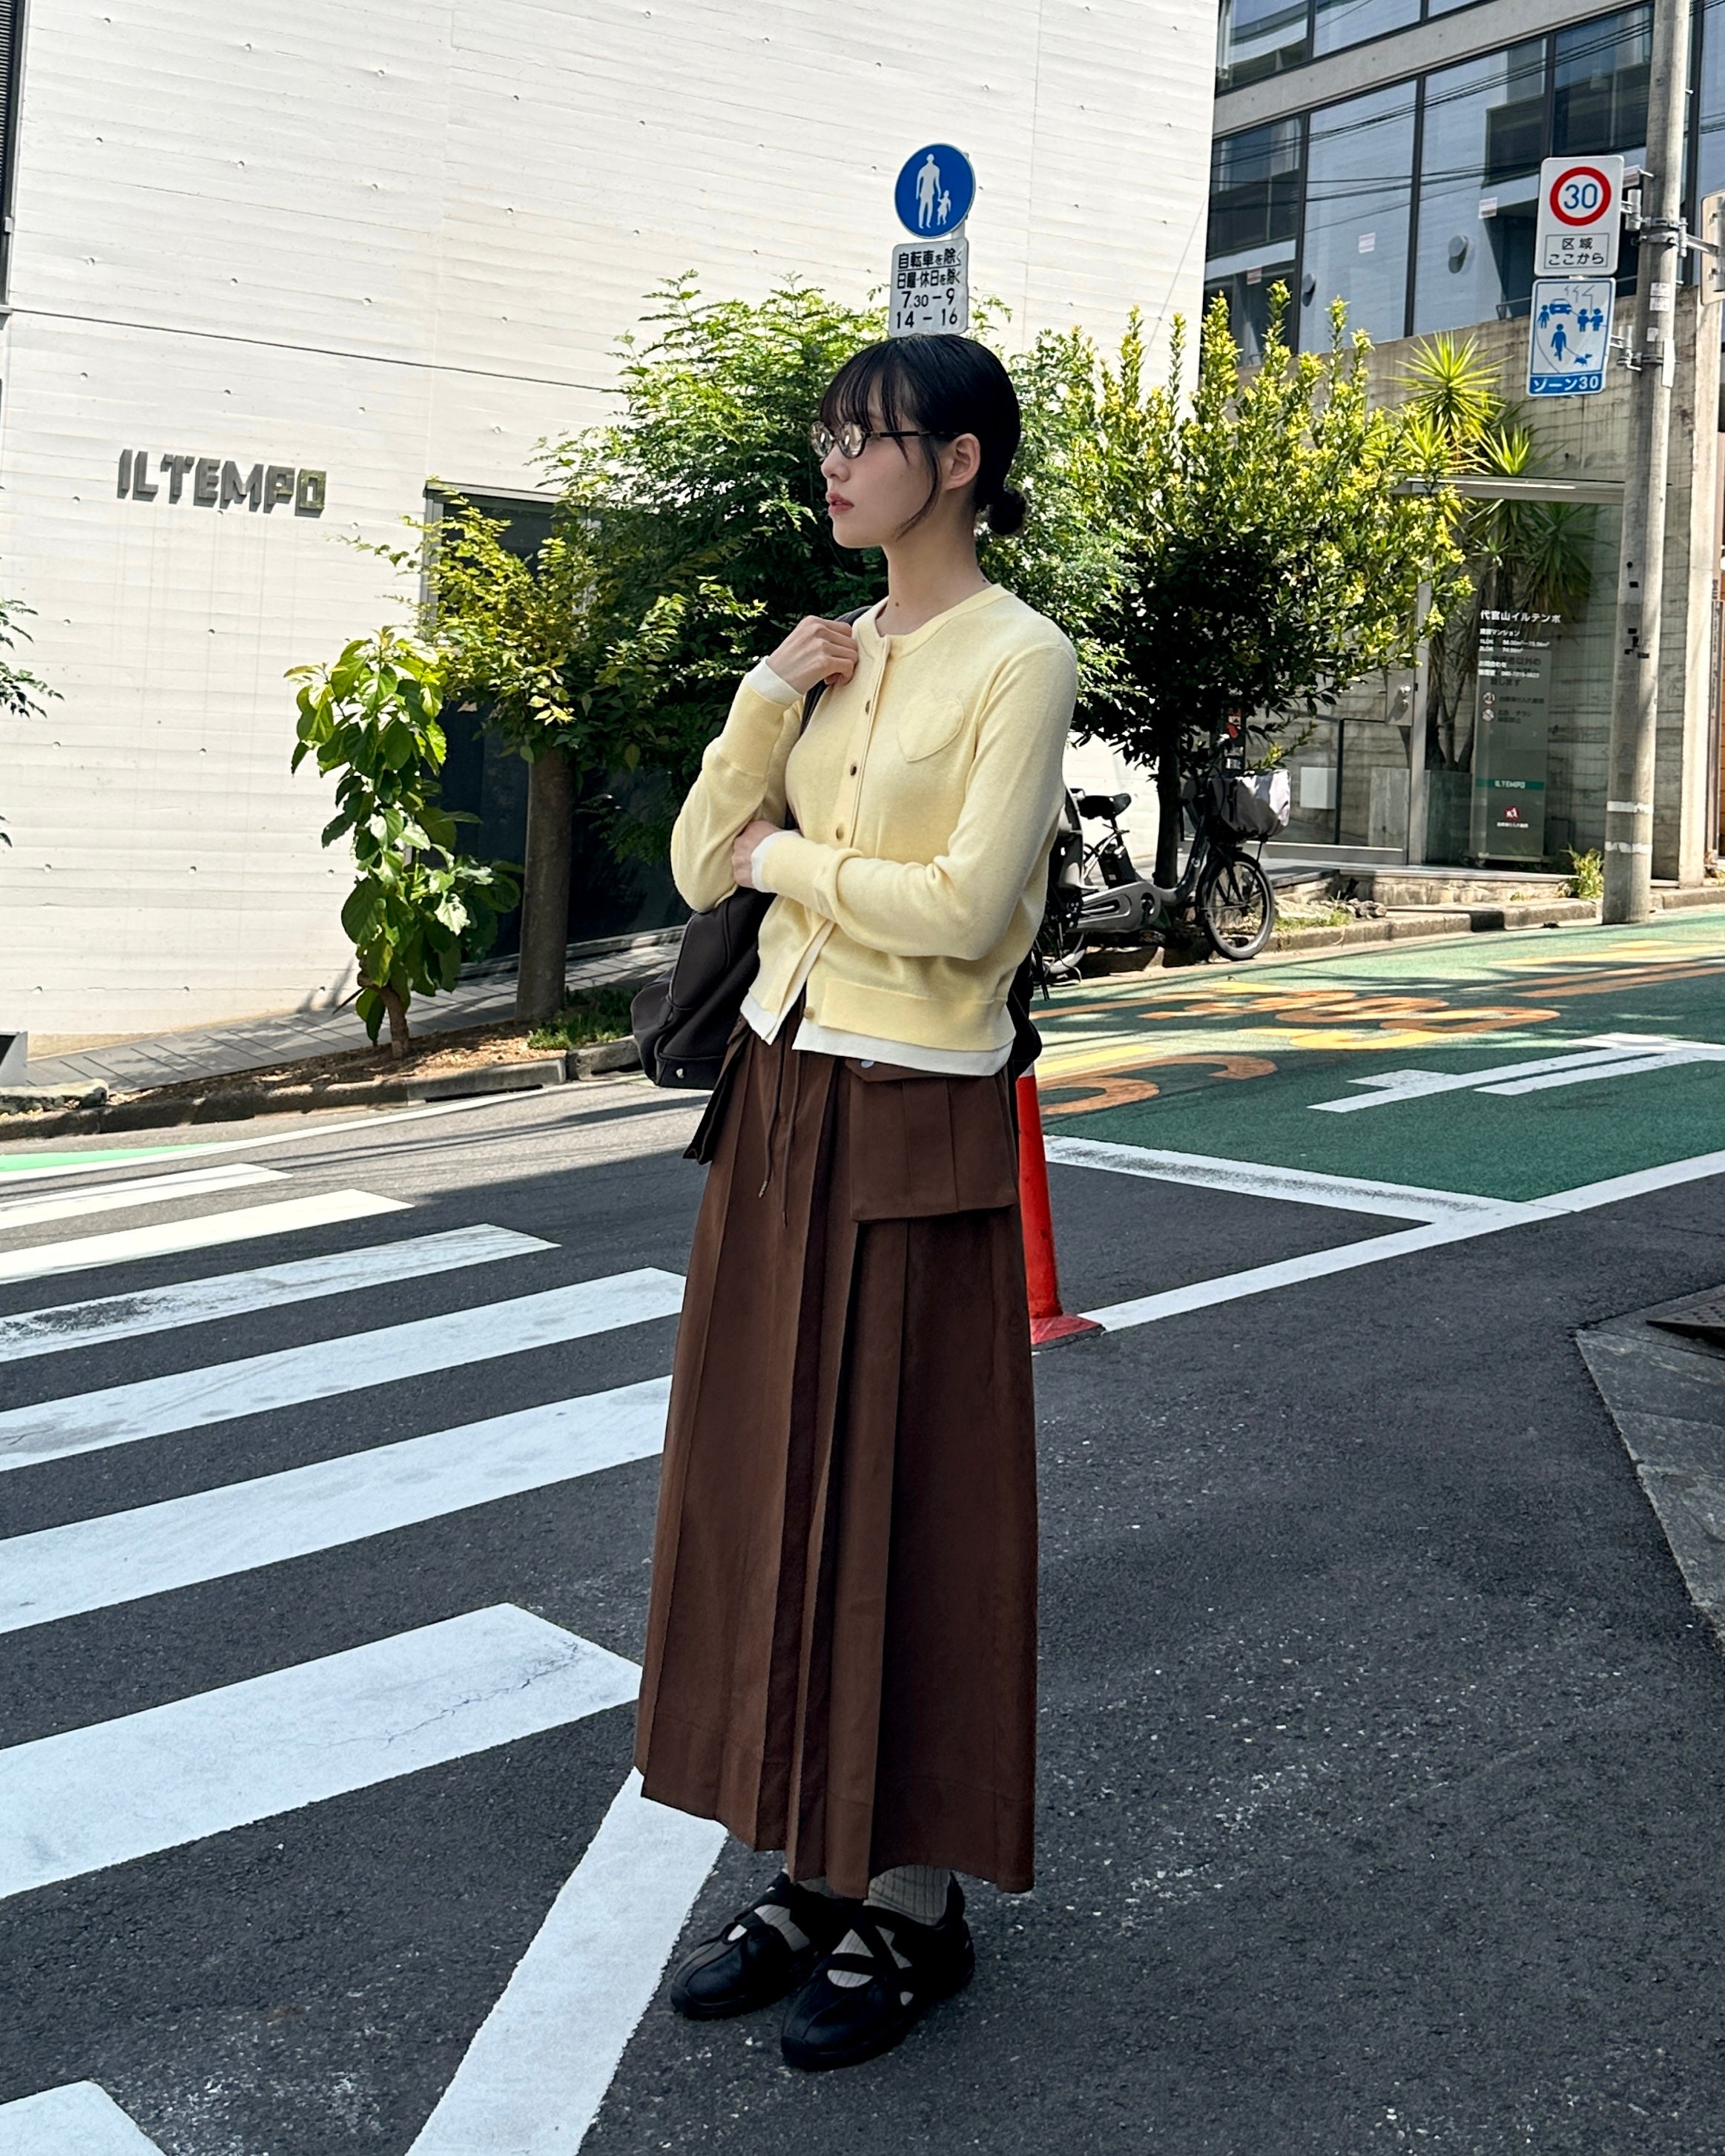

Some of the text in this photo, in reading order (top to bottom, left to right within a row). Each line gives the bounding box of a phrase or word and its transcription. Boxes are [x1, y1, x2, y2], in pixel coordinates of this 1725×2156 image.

[1563, 183, 1598, 210] 30
[1562, 237, 1593, 251] 区域
[898, 248, 962, 269] 自転車を除く
[1548, 252, 1604, 266] ここから
[1533, 375, 1600, 393] ゾーン30
